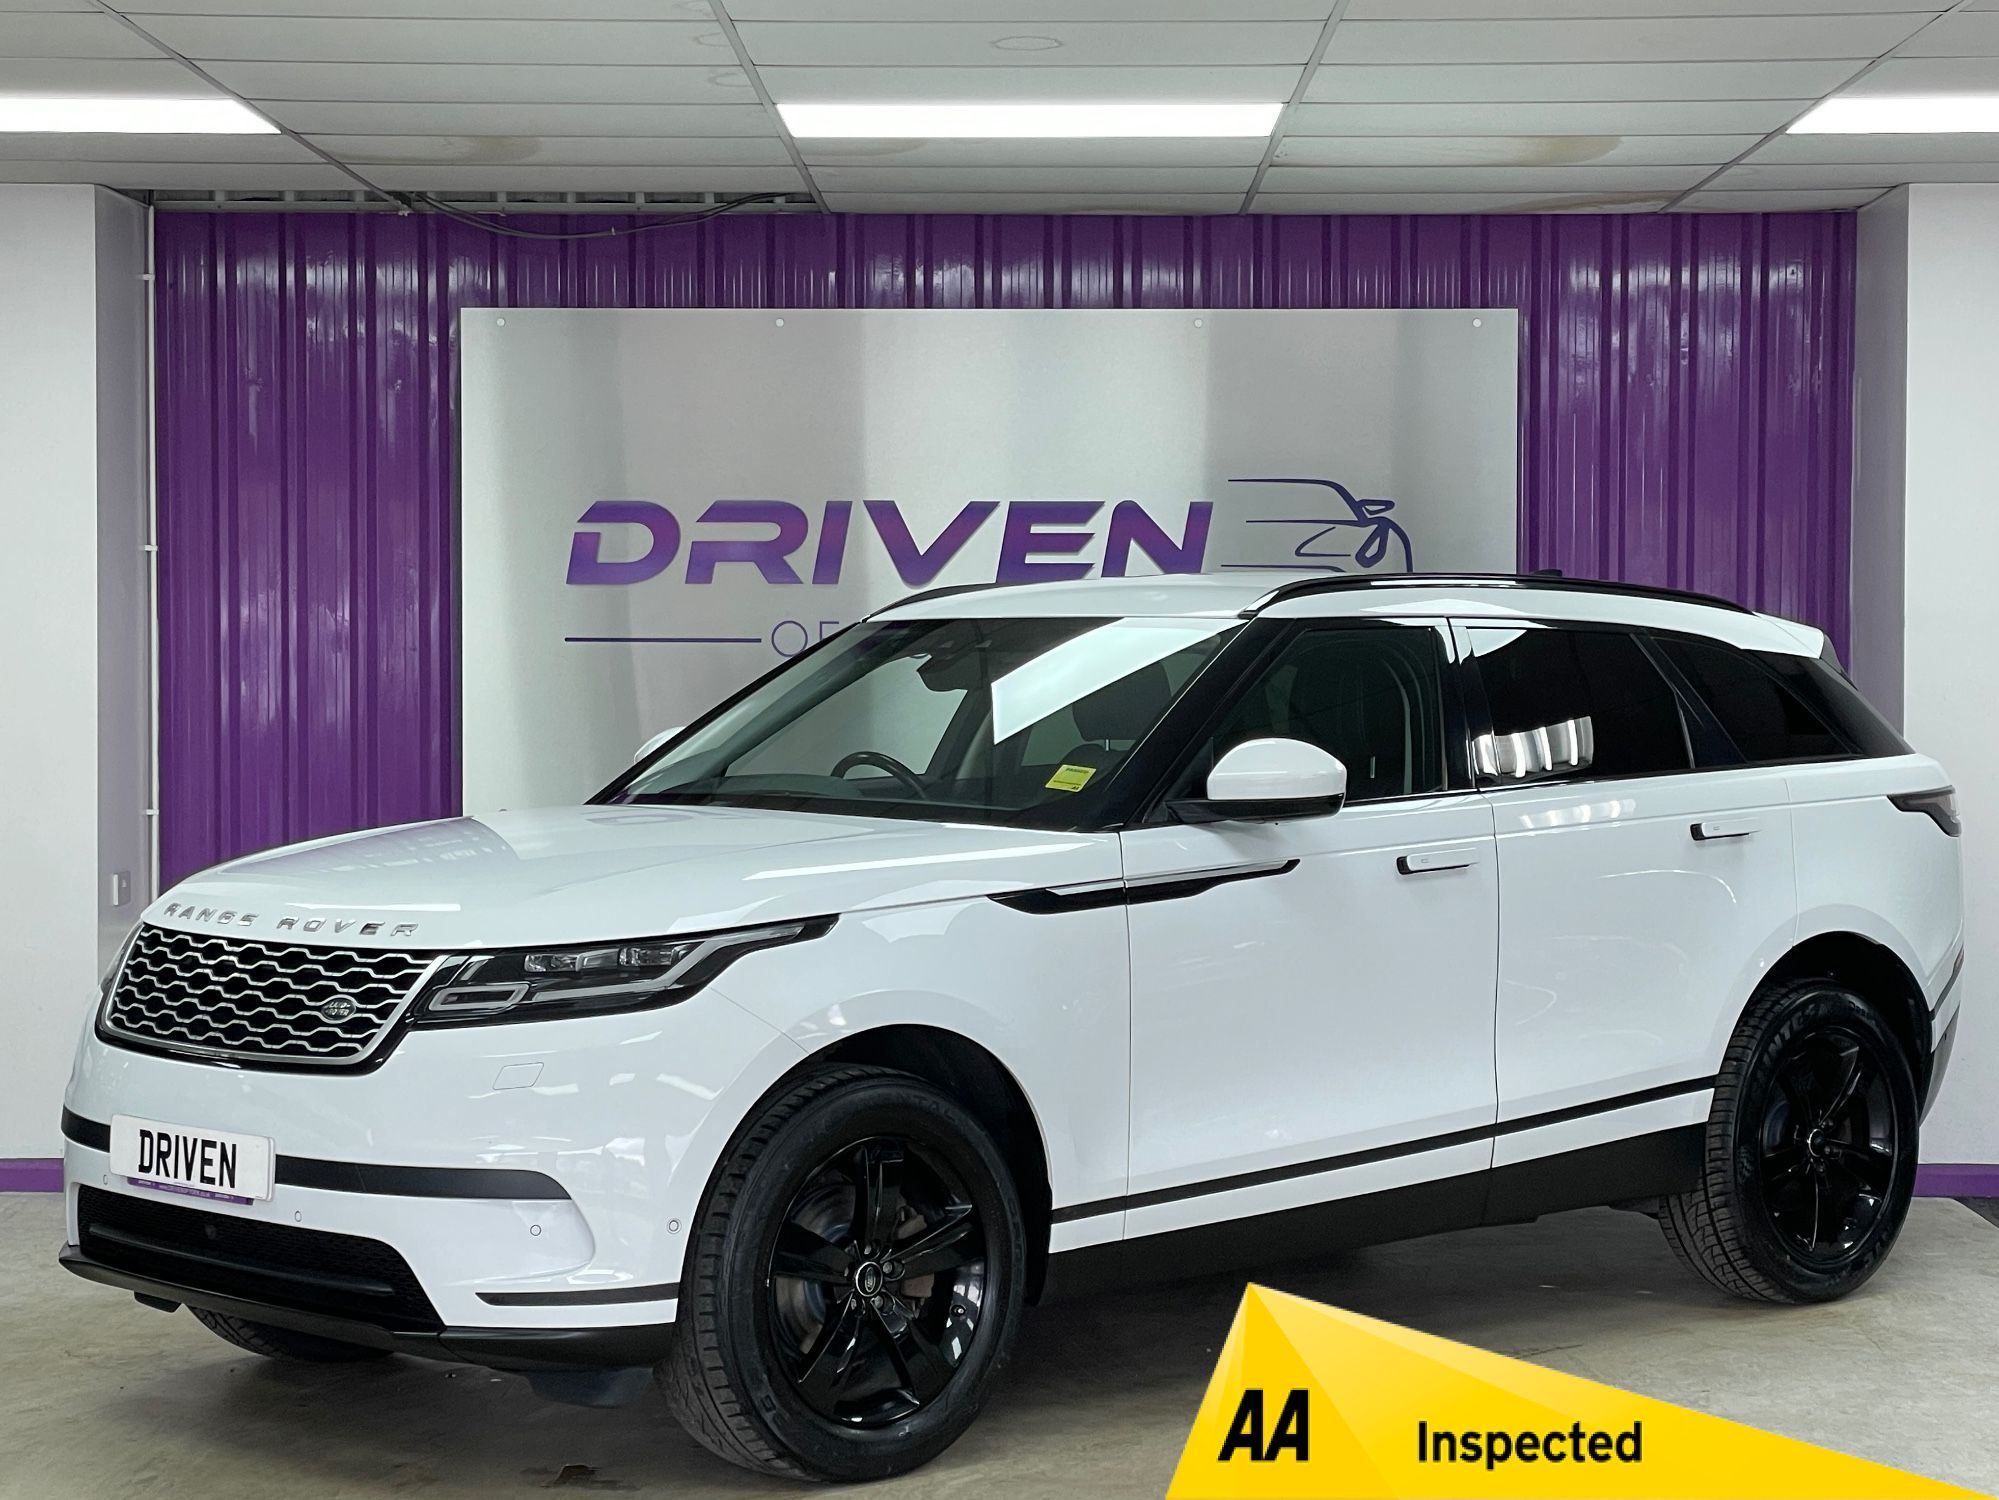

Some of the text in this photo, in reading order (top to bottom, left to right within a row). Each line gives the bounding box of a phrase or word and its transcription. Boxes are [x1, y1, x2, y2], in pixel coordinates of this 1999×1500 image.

[565, 500, 1214, 586] DRIVEN
[163, 902, 419, 937] RANGE ROVER
[138, 1128, 237, 1189] DRIVEN
